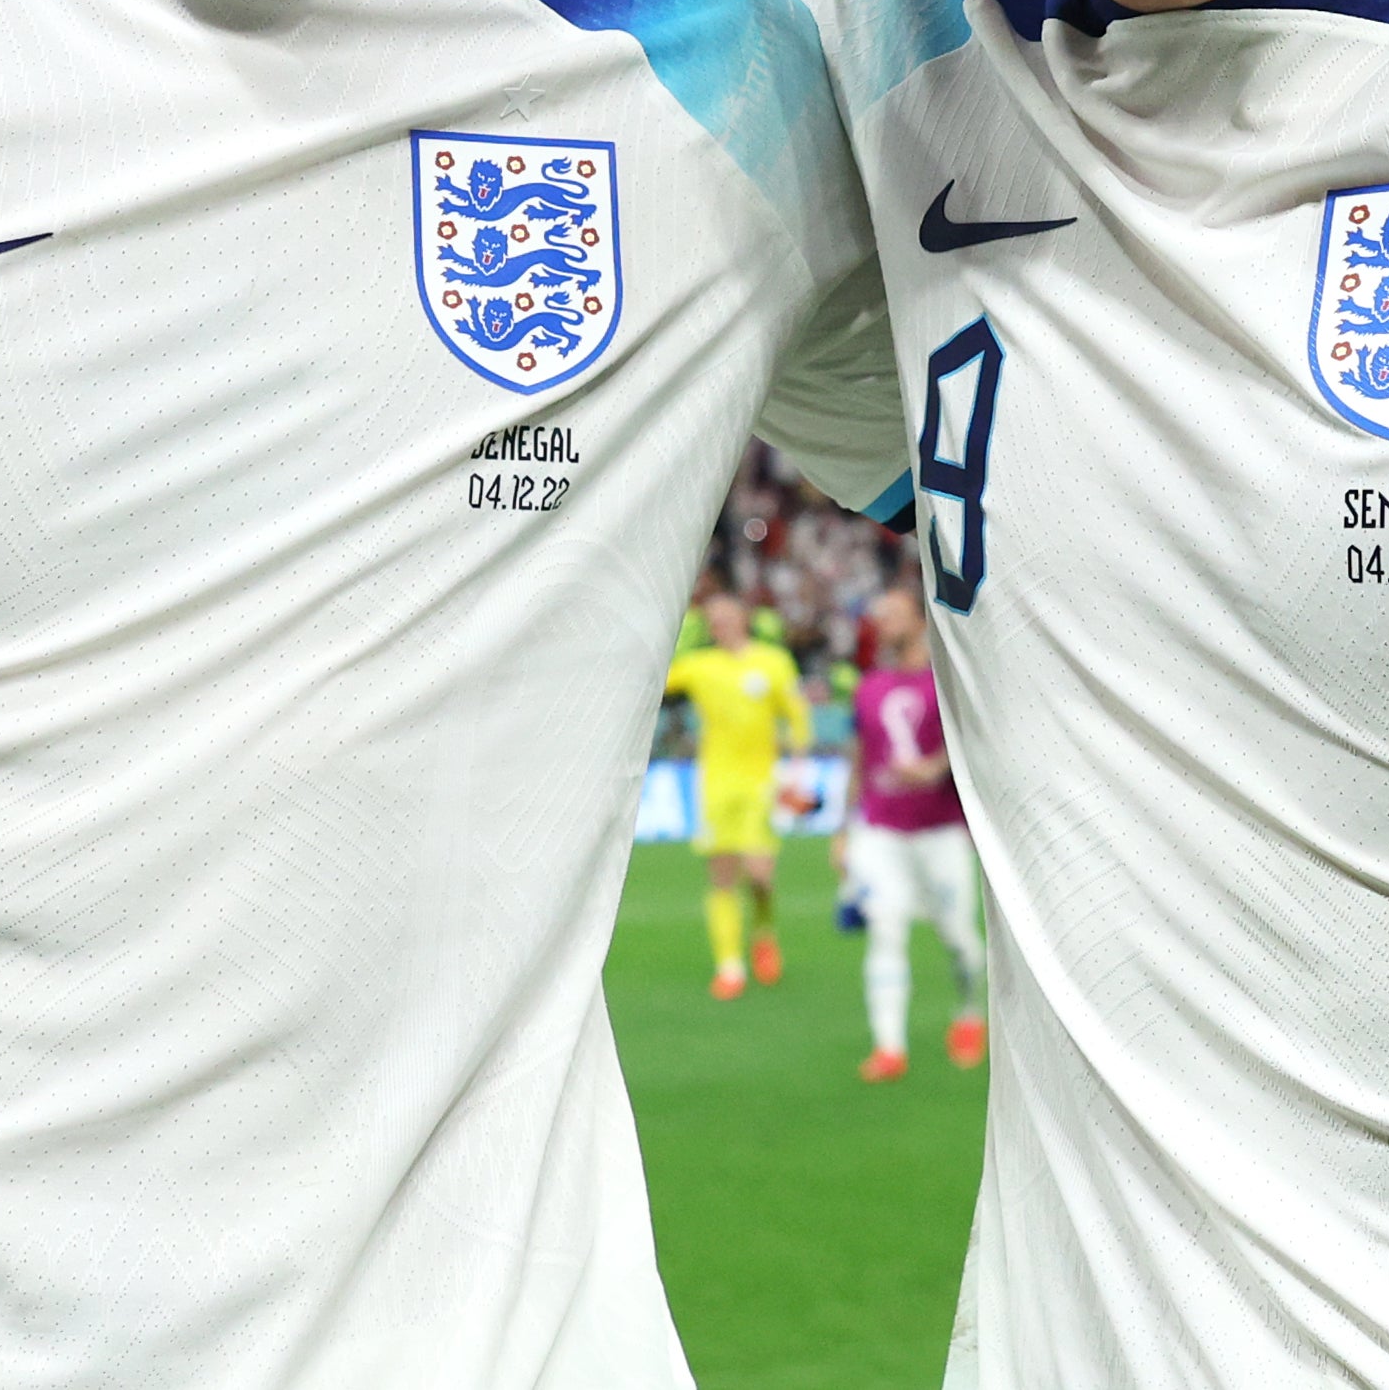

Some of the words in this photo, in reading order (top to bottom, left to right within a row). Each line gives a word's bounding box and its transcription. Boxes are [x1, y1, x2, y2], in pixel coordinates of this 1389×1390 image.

[470, 424, 580, 463] SENEGAL
[918, 312, 1007, 616] 9
[468, 472, 571, 511] 04.12.22
